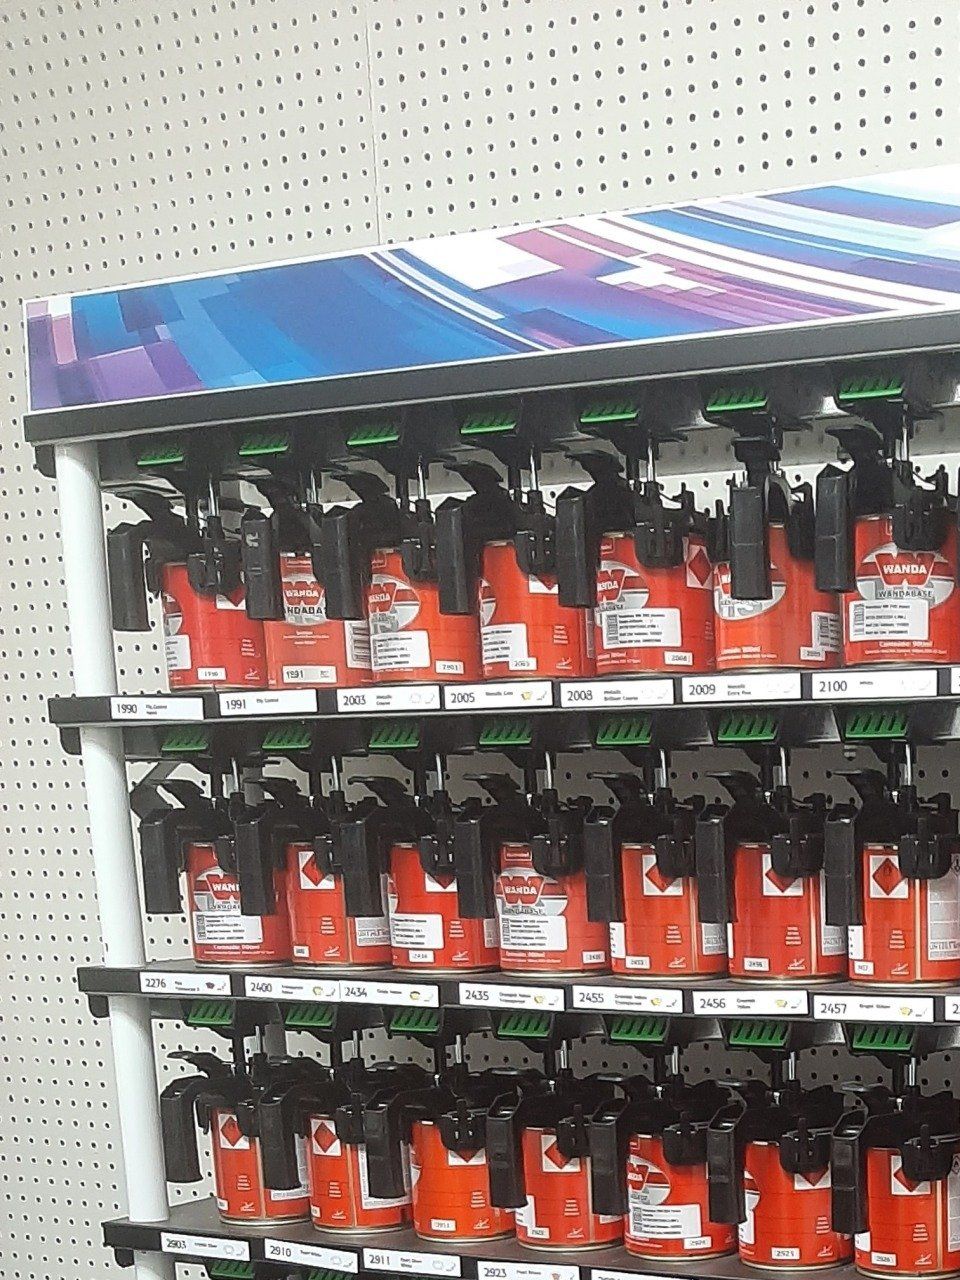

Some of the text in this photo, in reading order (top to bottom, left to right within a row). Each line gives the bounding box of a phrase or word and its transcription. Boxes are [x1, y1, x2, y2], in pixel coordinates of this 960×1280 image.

[883, 564, 927, 576] WANDA
[878, 588, 933, 599] WANDABASE
[689, 683, 716, 696] 2009
[819, 680, 848, 693] 2100
[343, 695, 366, 707] 2003
[450, 692, 475, 704] 2005
[567, 690, 593, 702] 2008
[116, 703, 137, 715] 1990
[225, 699, 247, 711] 1991
[145, 978, 167, 989] 2276
[251, 981, 272, 993] 2400
[345, 986, 368, 998] 2434
[465, 989, 489, 1001] 2435
[579, 992, 604, 1004] 2455
[700, 997, 726, 1010] 2456
[820, 1002, 847, 1015] 2457
[166, 1238, 187, 1250] 2903
[270, 1245, 292, 1258] 2910
[369, 1254, 391, 1266] 2911
[484, 1266, 507, 1278] 2923
